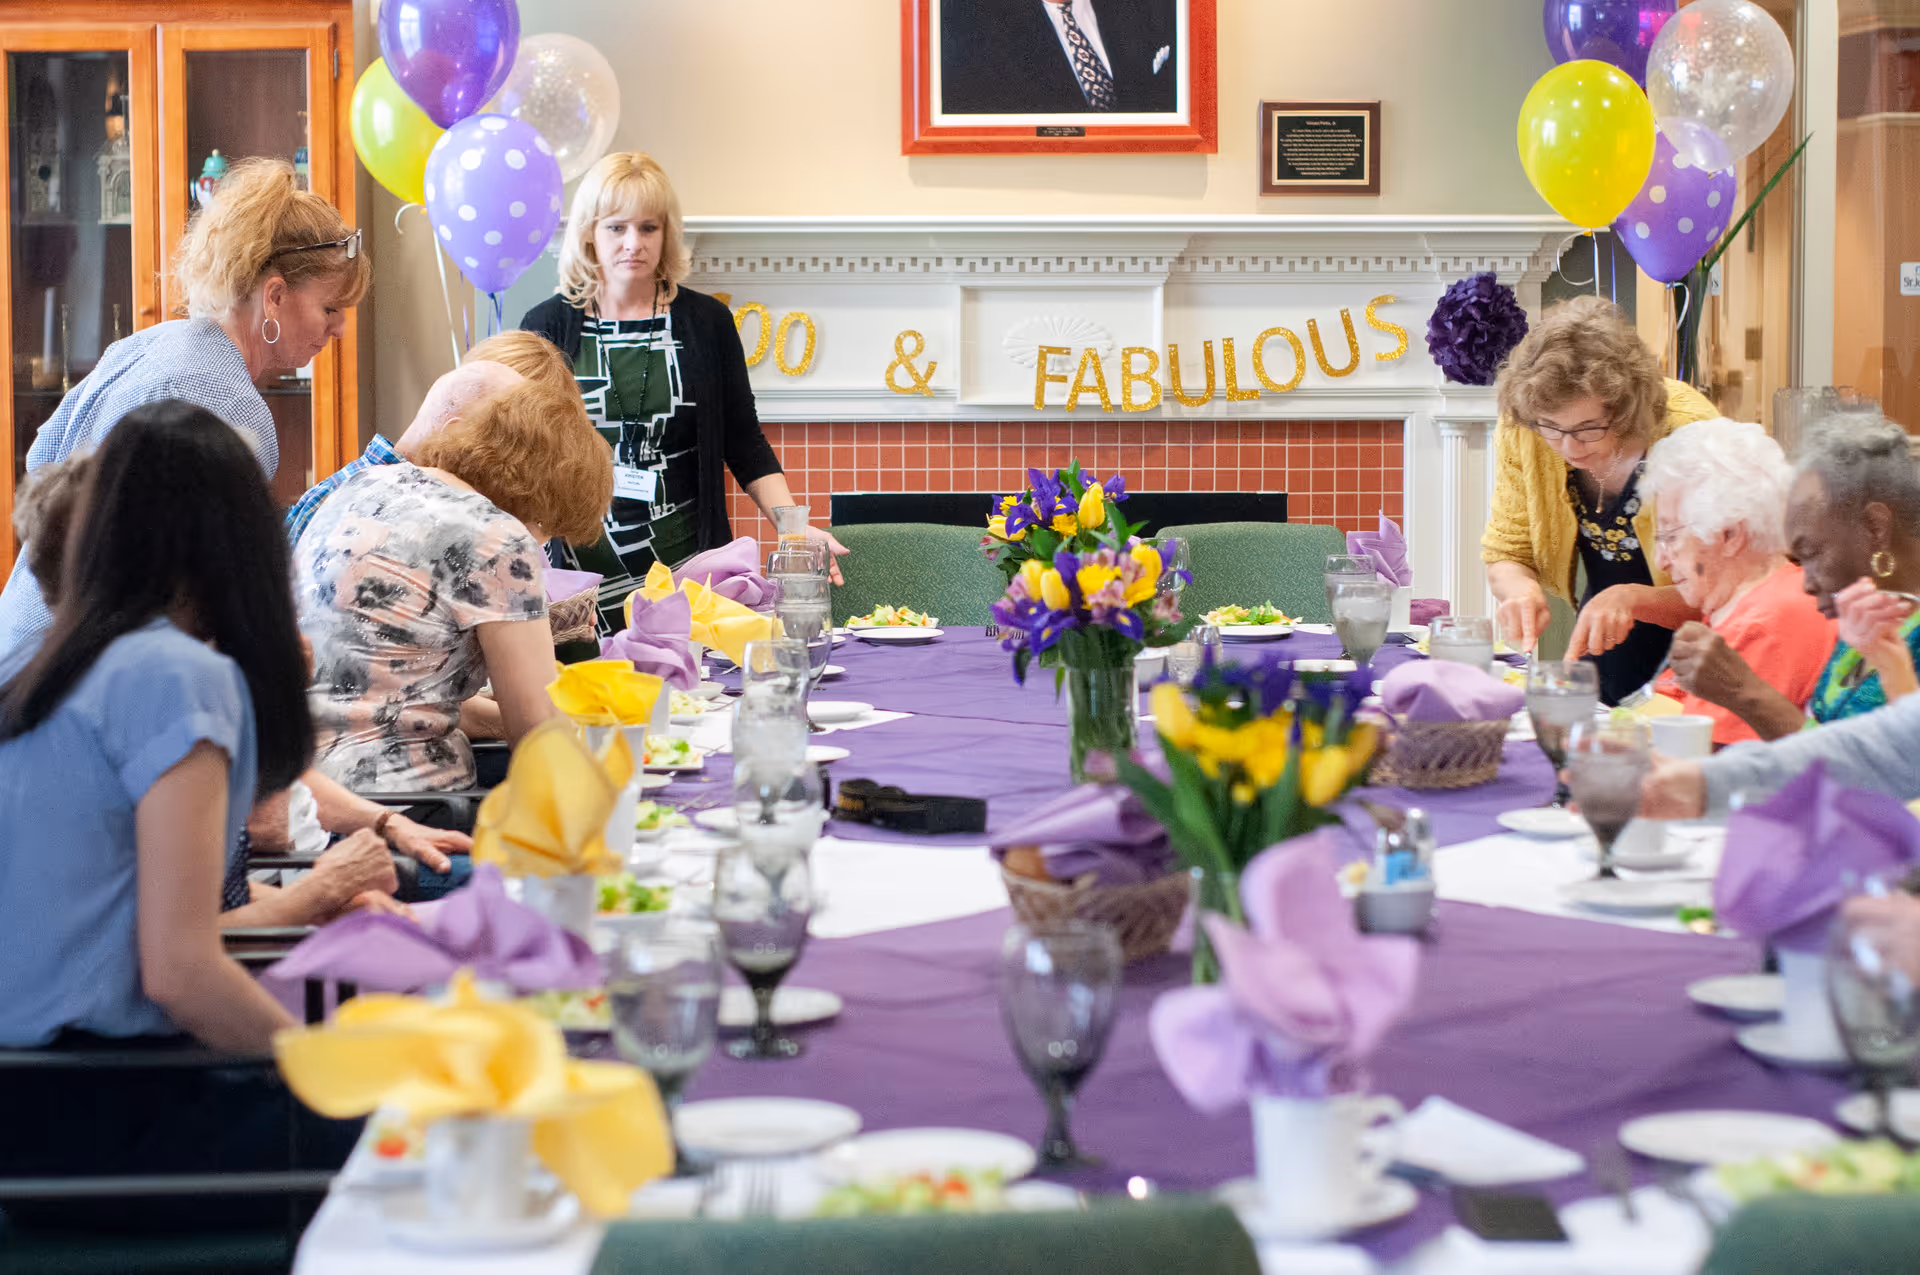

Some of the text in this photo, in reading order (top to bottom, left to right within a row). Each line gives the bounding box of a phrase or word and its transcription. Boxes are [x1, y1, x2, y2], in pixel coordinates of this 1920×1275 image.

[712, 293, 1409, 413] 00 & FABULOUS
